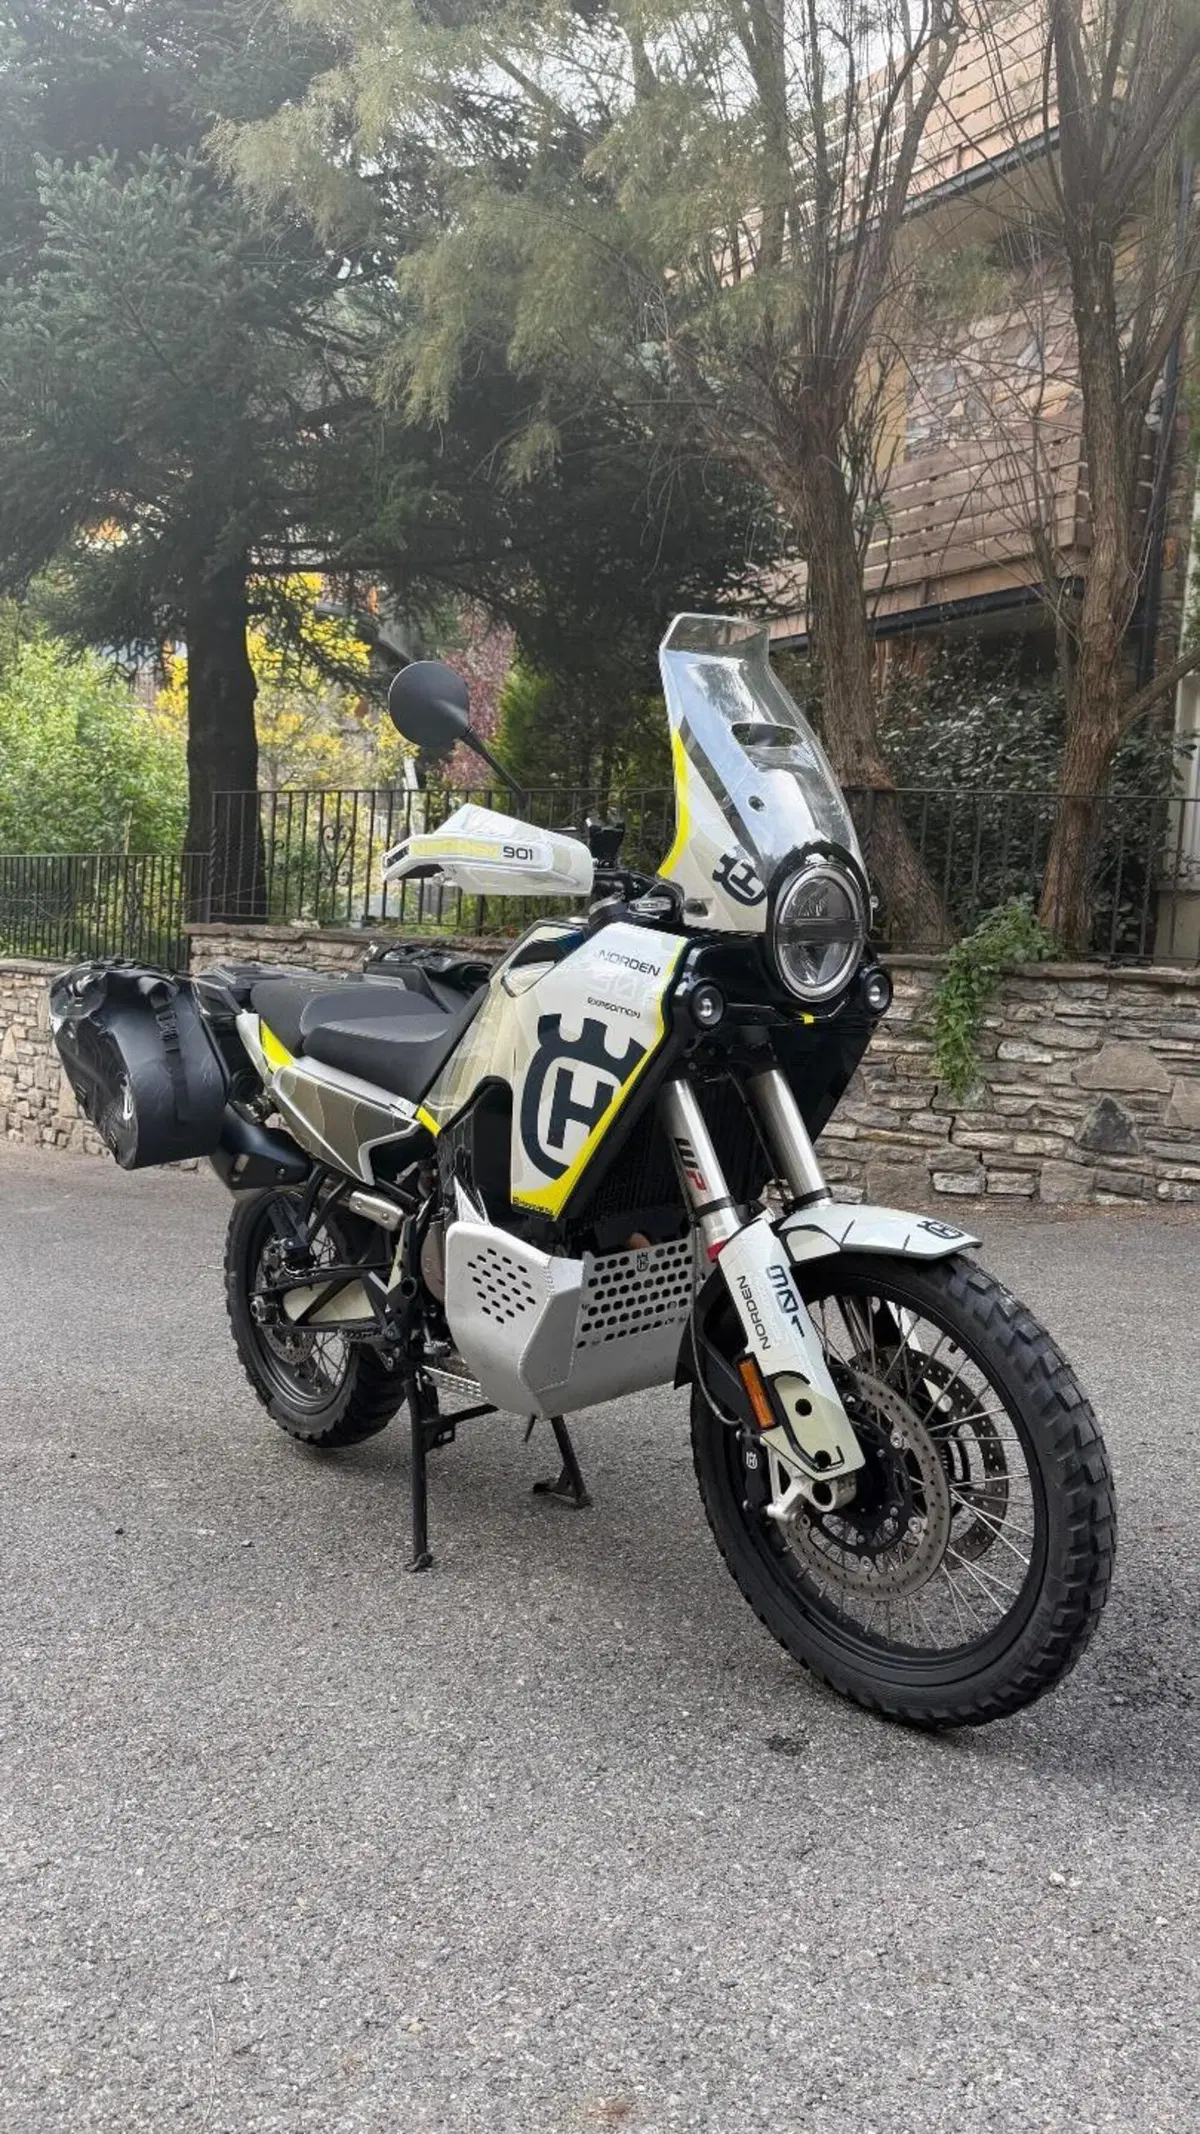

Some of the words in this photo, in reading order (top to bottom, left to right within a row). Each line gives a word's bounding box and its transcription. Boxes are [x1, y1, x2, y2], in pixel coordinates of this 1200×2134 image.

[502, 845, 534, 861] 901
[597, 949, 662, 977] NORDEN
[736, 1274, 772, 1351] NORDEN
